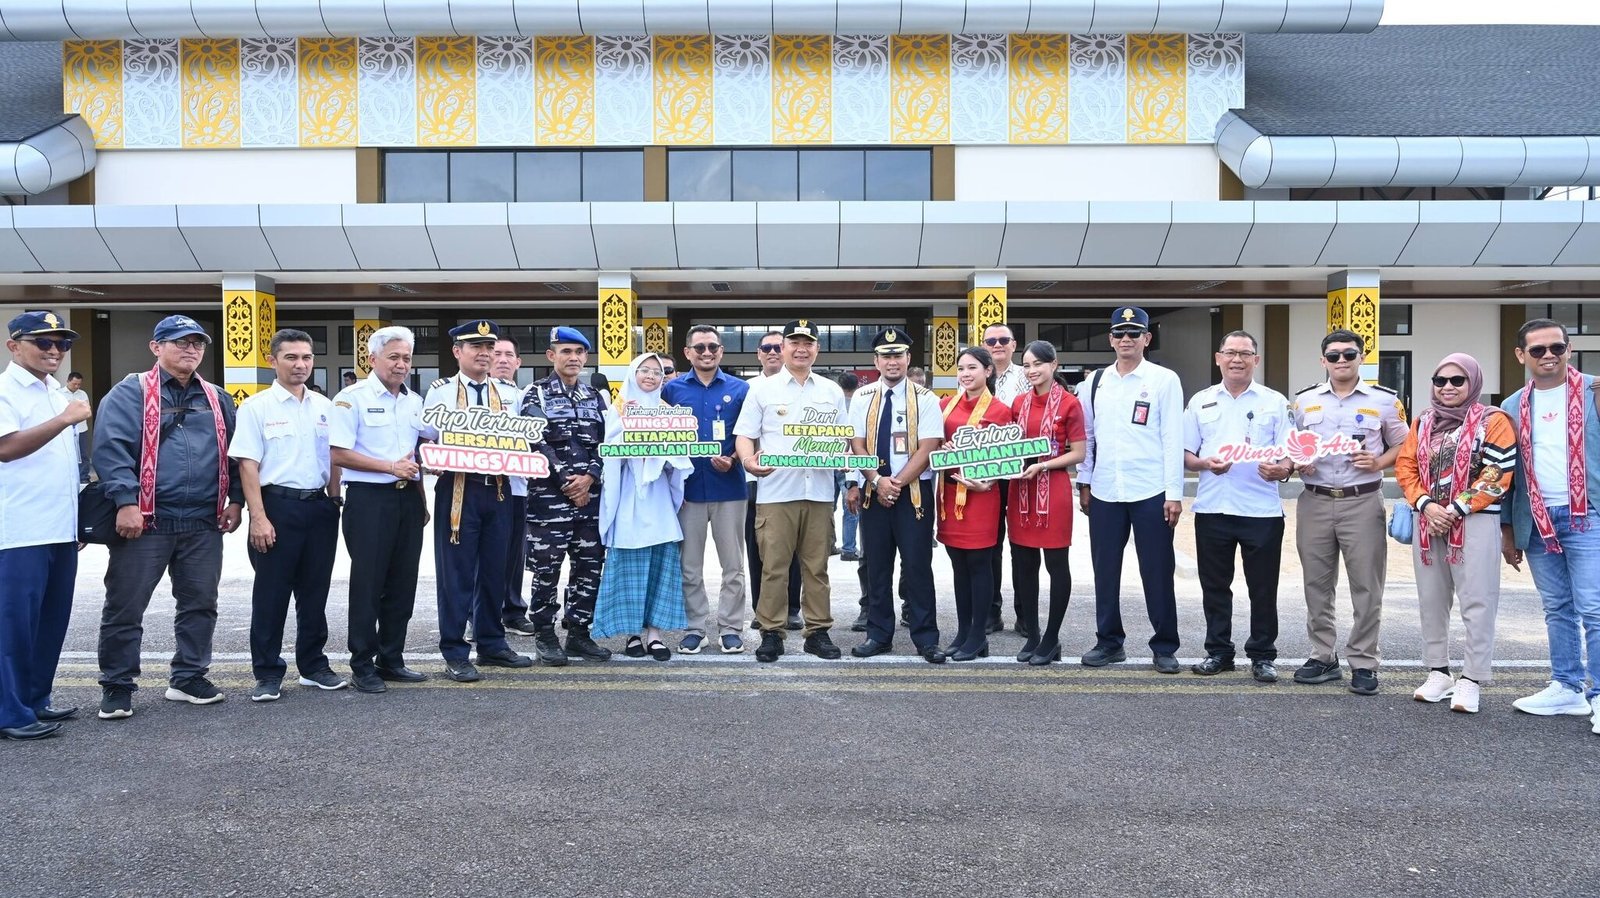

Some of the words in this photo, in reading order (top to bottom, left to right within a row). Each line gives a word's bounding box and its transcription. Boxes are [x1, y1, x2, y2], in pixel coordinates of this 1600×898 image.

[627, 406, 657, 416] Terbang
[659, 405, 691, 416] Perdana
[800, 407, 838, 424] Dari
[423, 404, 467, 431] Ayo
[469, 408, 545, 440] Terbang
[622, 417, 669, 429] WINGS
[669, 417, 697, 429] AIR
[783, 424, 855, 437] KETAPANG
[442, 431, 528, 452] BERSAMA
[623, 430, 697, 443] KETAPANG
[955, 424, 1019, 449] Explore
[600, 444, 688, 457] PANGKALAN
[689, 443, 720, 456] BUN
[793, 437, 846, 457] Menuju
[931, 439, 1050, 467] KALIMANTAN
[1219, 444, 1284, 461] Wings
[1321, 434, 1358, 454] Air
[423, 447, 504, 472] WINGS
[504, 453, 549, 475] AIR
[760, 455, 846, 468] PANGKALAN
[848, 456, 878, 468] BUN
[962, 459, 1022, 479] BARAT
